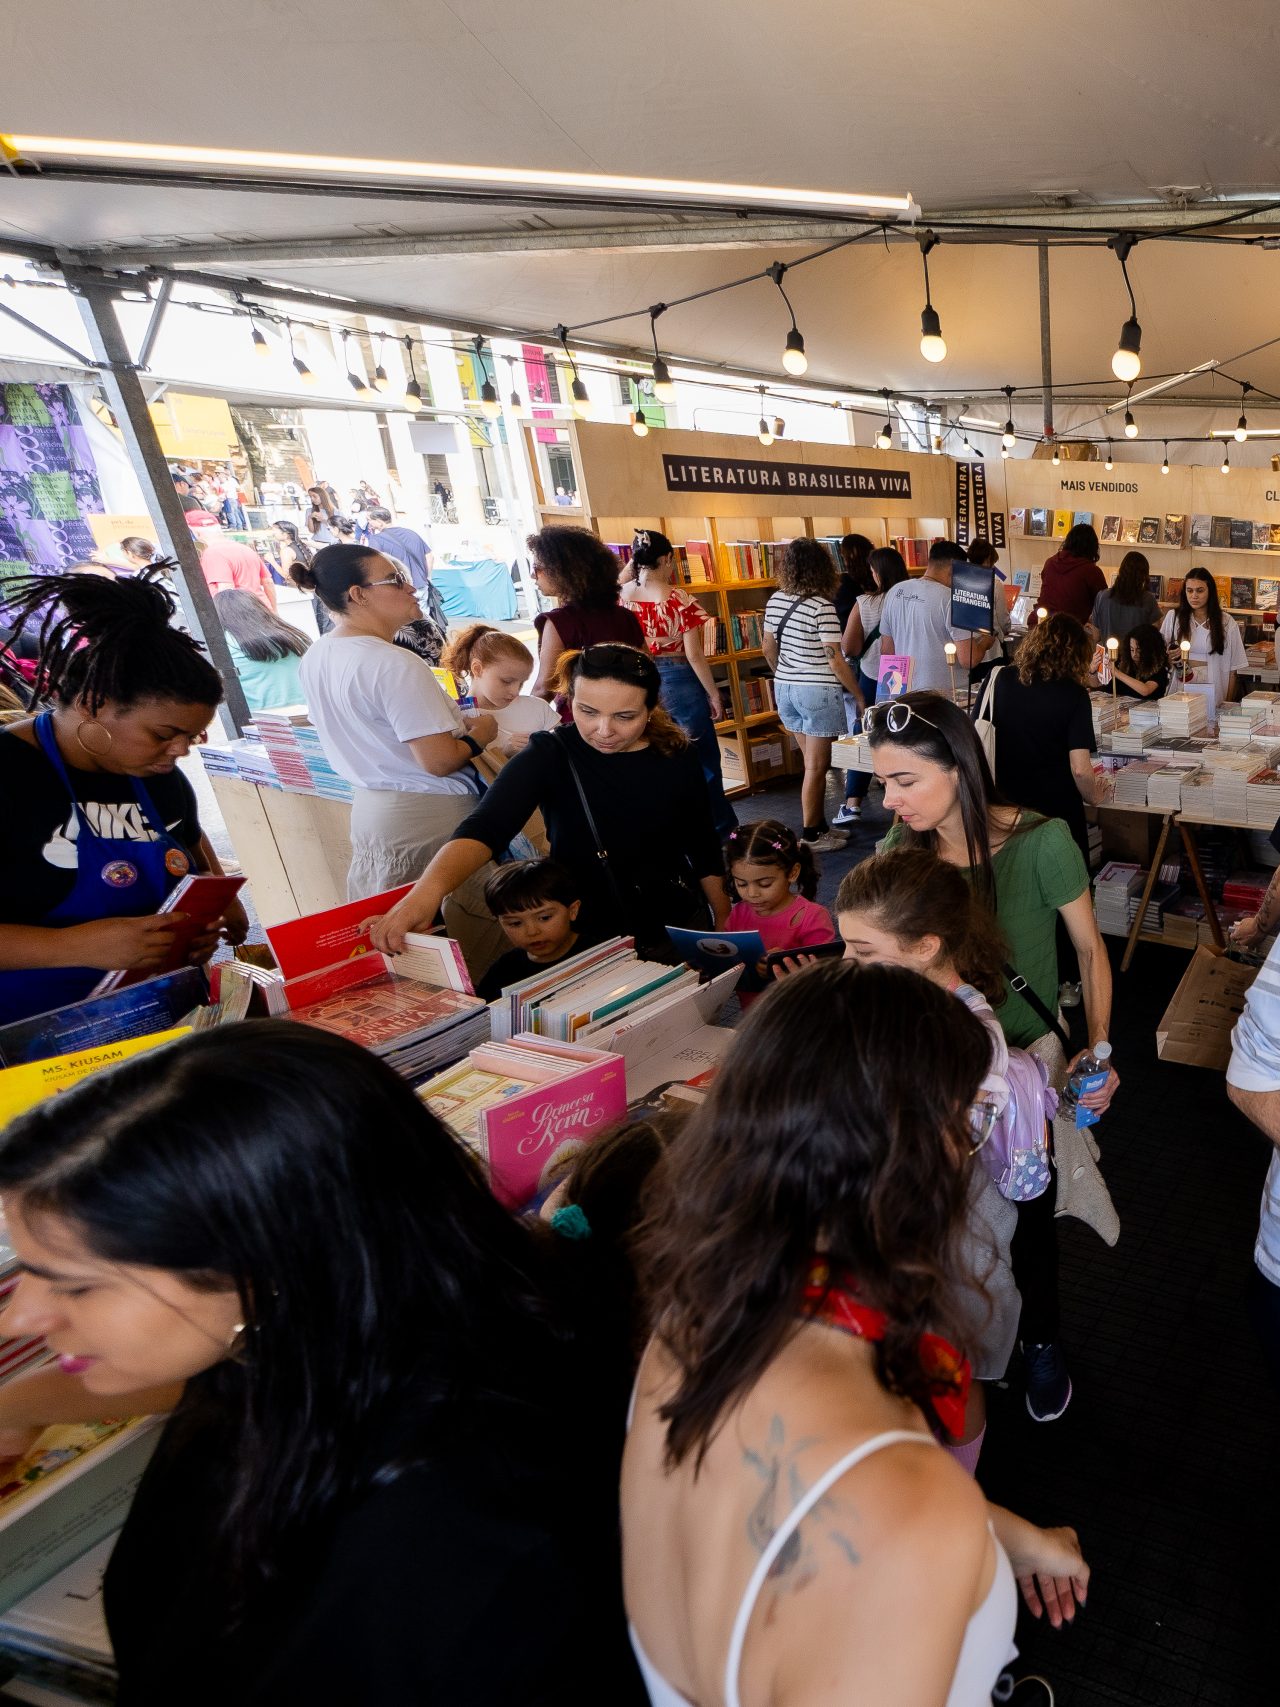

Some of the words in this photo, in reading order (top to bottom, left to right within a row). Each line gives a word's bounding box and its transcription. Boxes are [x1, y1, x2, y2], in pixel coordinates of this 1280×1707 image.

[668, 464, 781, 486] LITERATURA
[788, 472, 875, 490] BRASILEIRA
[881, 477, 909, 492] VIVA
[1061, 480, 1086, 491] MAIS
[1088, 482, 1138, 493] VENDIDOS
[958, 465, 967, 543] LITERATURA
[995, 515, 1003, 545] VIVA
[952, 595, 991, 609] ESTRANGEIRA
[955, 589, 988, 602] LITERATURA
[360, 1009, 436, 1042] JANELA
[42, 1065, 67, 1076] MS.
[69, 1050, 124, 1068] KIUSAM
[528, 1091, 594, 1135] Princesa
